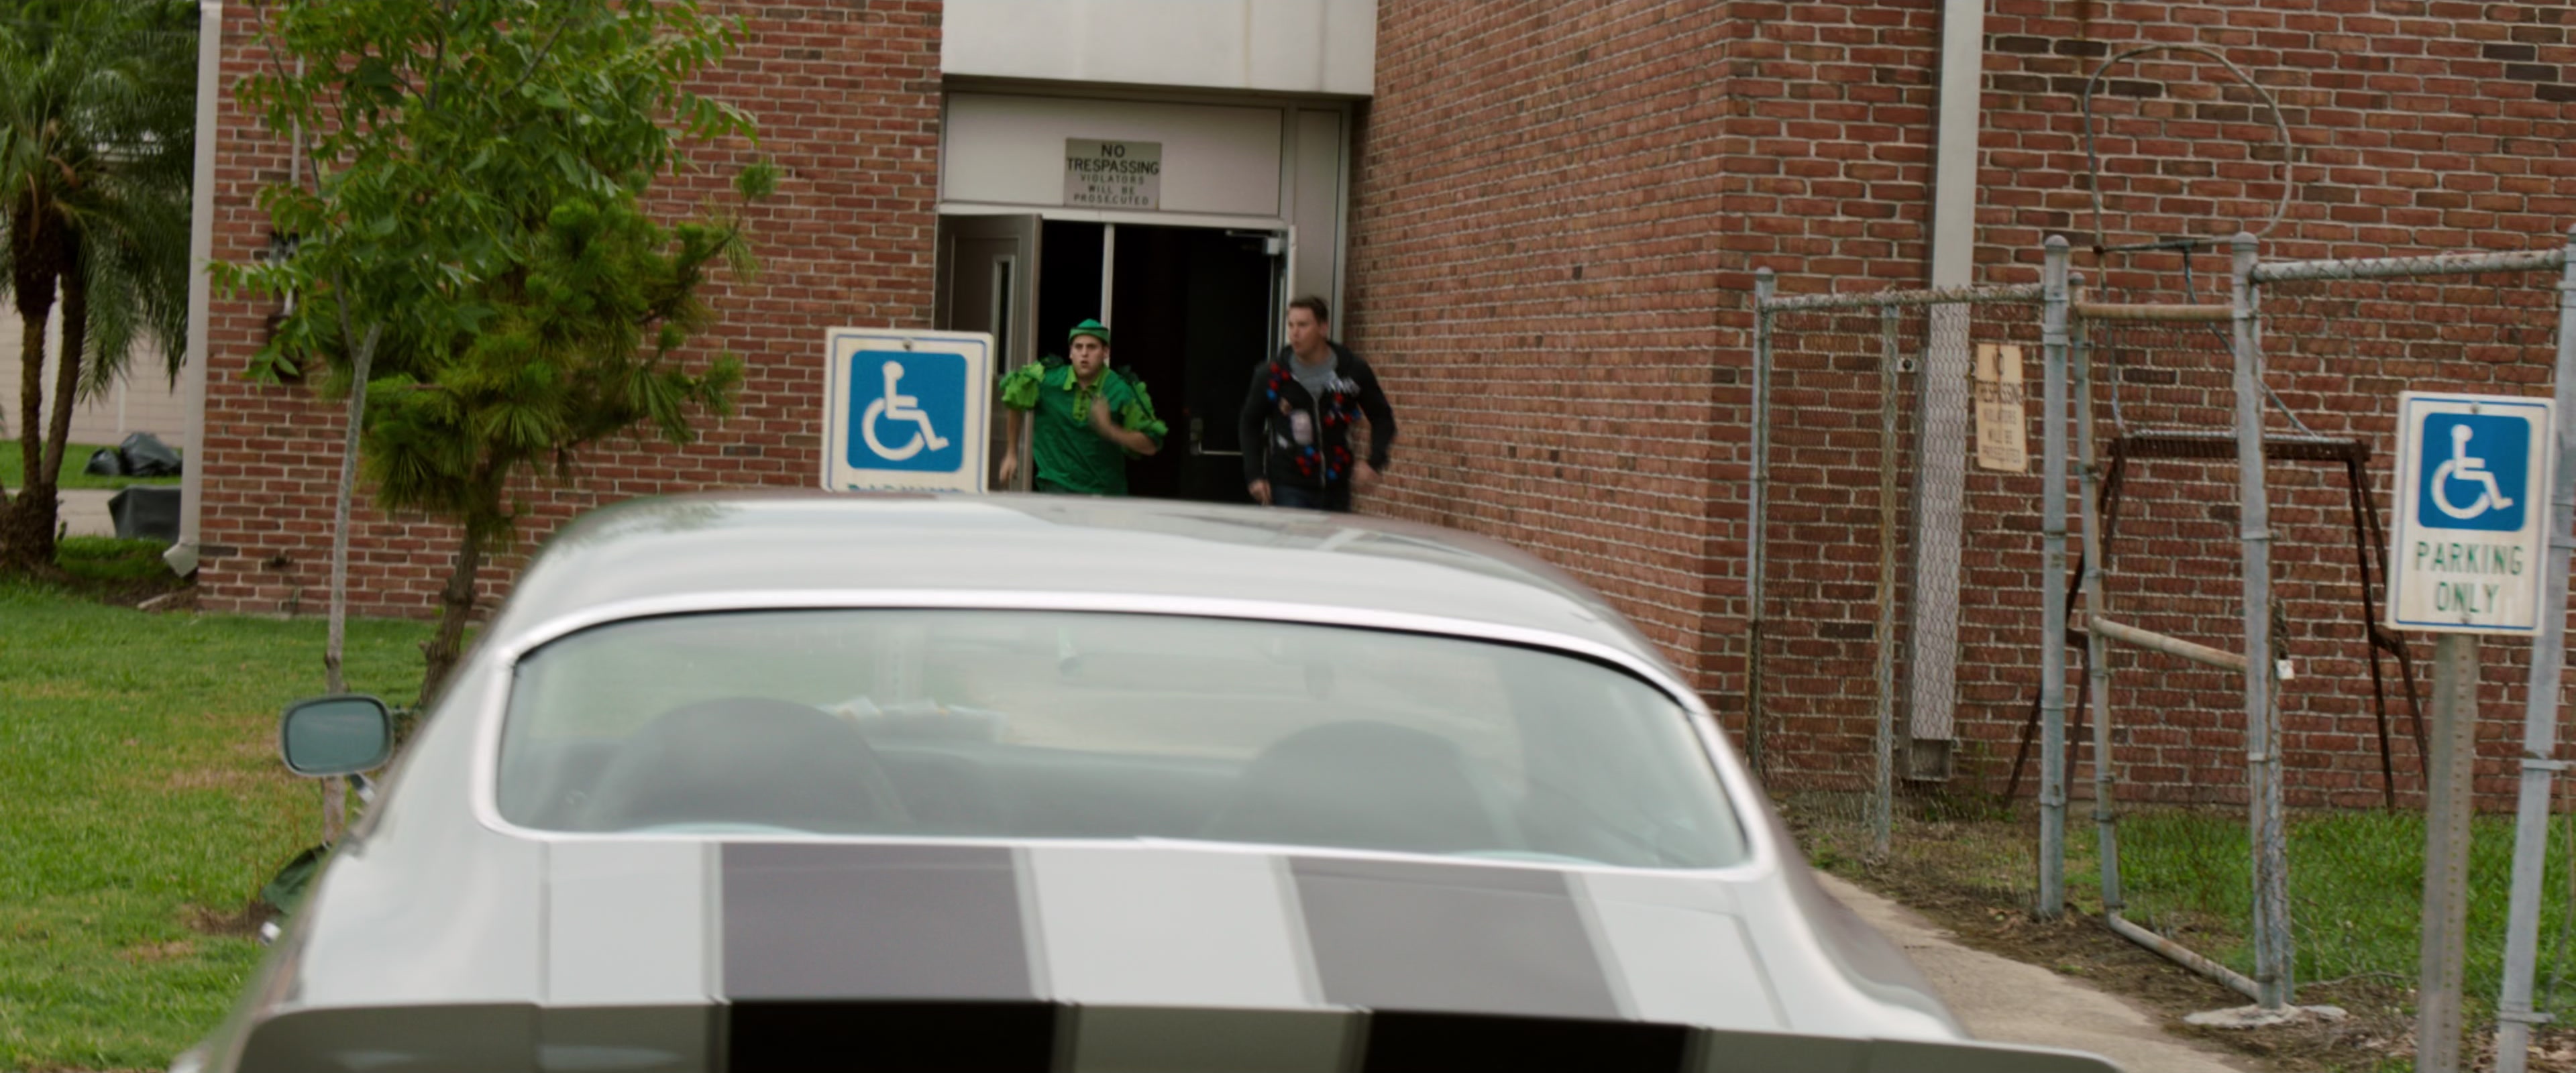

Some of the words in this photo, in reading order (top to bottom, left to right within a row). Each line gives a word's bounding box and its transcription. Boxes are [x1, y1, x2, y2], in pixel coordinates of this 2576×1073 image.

[1101, 144, 1126, 158] NO
[1067, 157, 1159, 175] TRESPASSING
[1081, 174, 1144, 184] VIOLATORS
[1089, 186, 1113, 194] WILL
[2415, 541, 2524, 575] PARKING
[2436, 581, 2500, 613] ONLY
